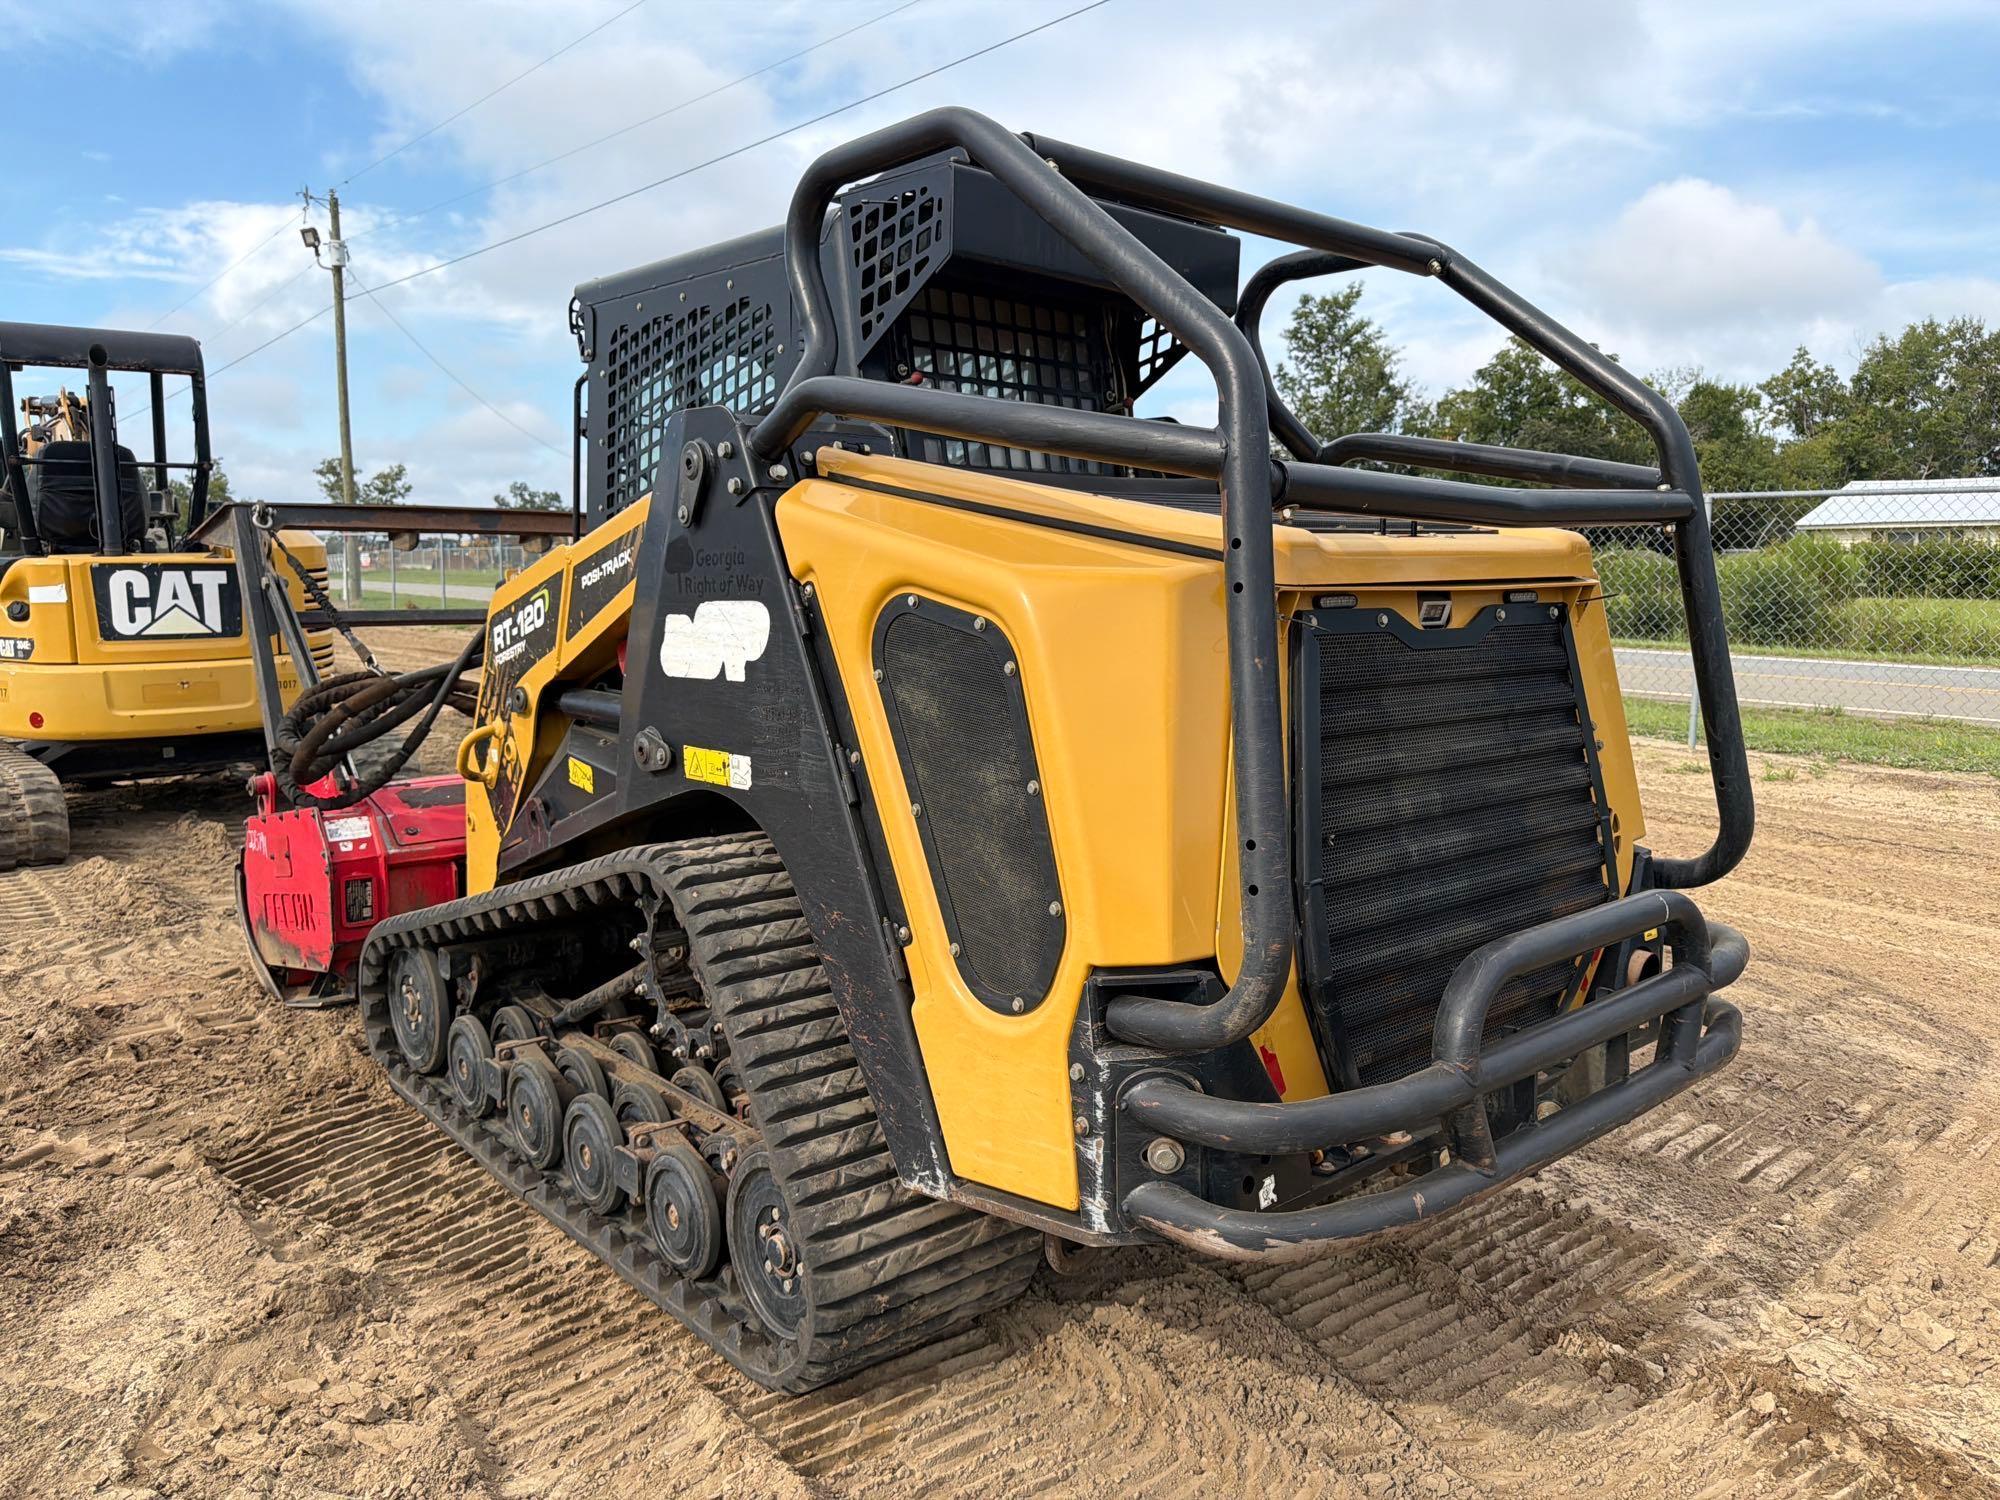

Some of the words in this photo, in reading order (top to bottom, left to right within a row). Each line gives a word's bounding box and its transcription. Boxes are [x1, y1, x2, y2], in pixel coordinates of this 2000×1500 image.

[581, 549, 632, 589] POSI-TRACK
[696, 547, 745, 571] Georgia
[109, 569, 228, 636] CAT
[685, 576, 716, 597] Right
[719, 576, 734, 595] of
[736, 575, 764, 595] Way
[493, 598, 545, 653] RT-120
[494, 640, 527, 666] FORESTRY
